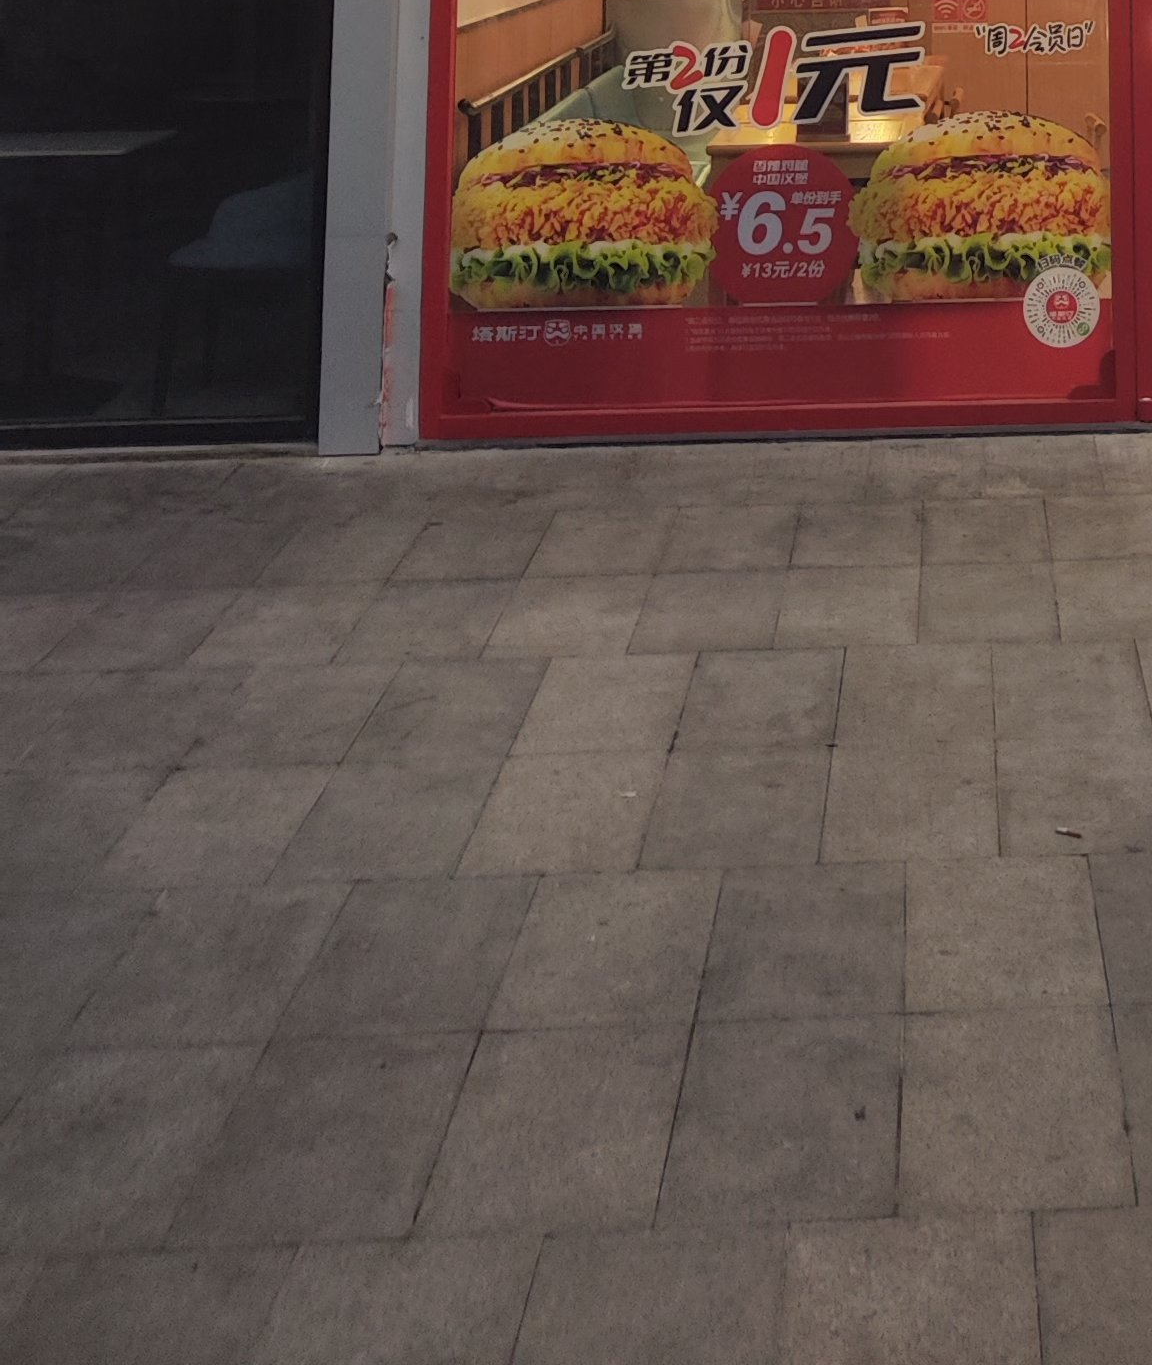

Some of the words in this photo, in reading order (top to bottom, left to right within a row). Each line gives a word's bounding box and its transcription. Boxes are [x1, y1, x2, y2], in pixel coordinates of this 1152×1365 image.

[625, 42, 748, 90] 第2份
[674, 83, 744, 135] 仅
[753, 173, 808, 186] 中国汉堡
[790, 191, 842, 205] 单份到手
[471, 325, 542, 342] 塔斯汀
